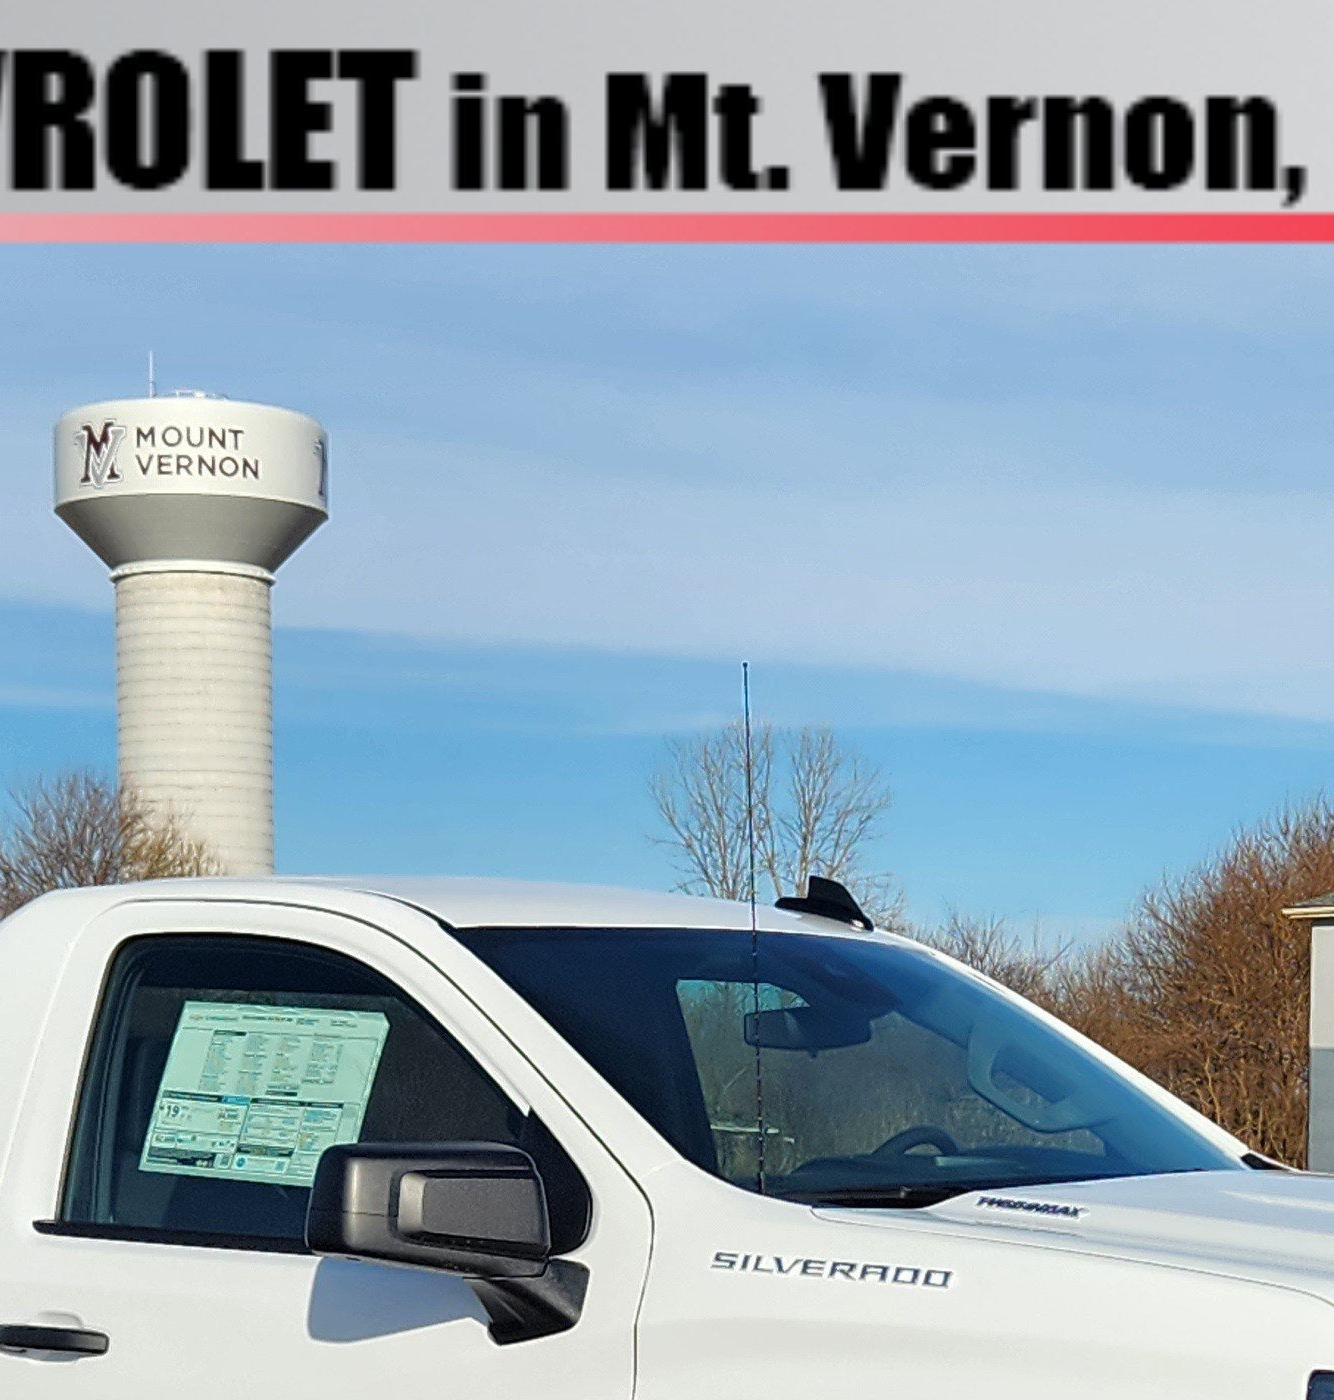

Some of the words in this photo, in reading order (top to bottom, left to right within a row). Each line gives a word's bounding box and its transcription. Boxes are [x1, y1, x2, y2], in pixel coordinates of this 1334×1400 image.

[136, 426, 245, 450] MOUNT
[136, 454, 259, 480] VERNON
[710, 1250, 954, 1288] SILVERADO
